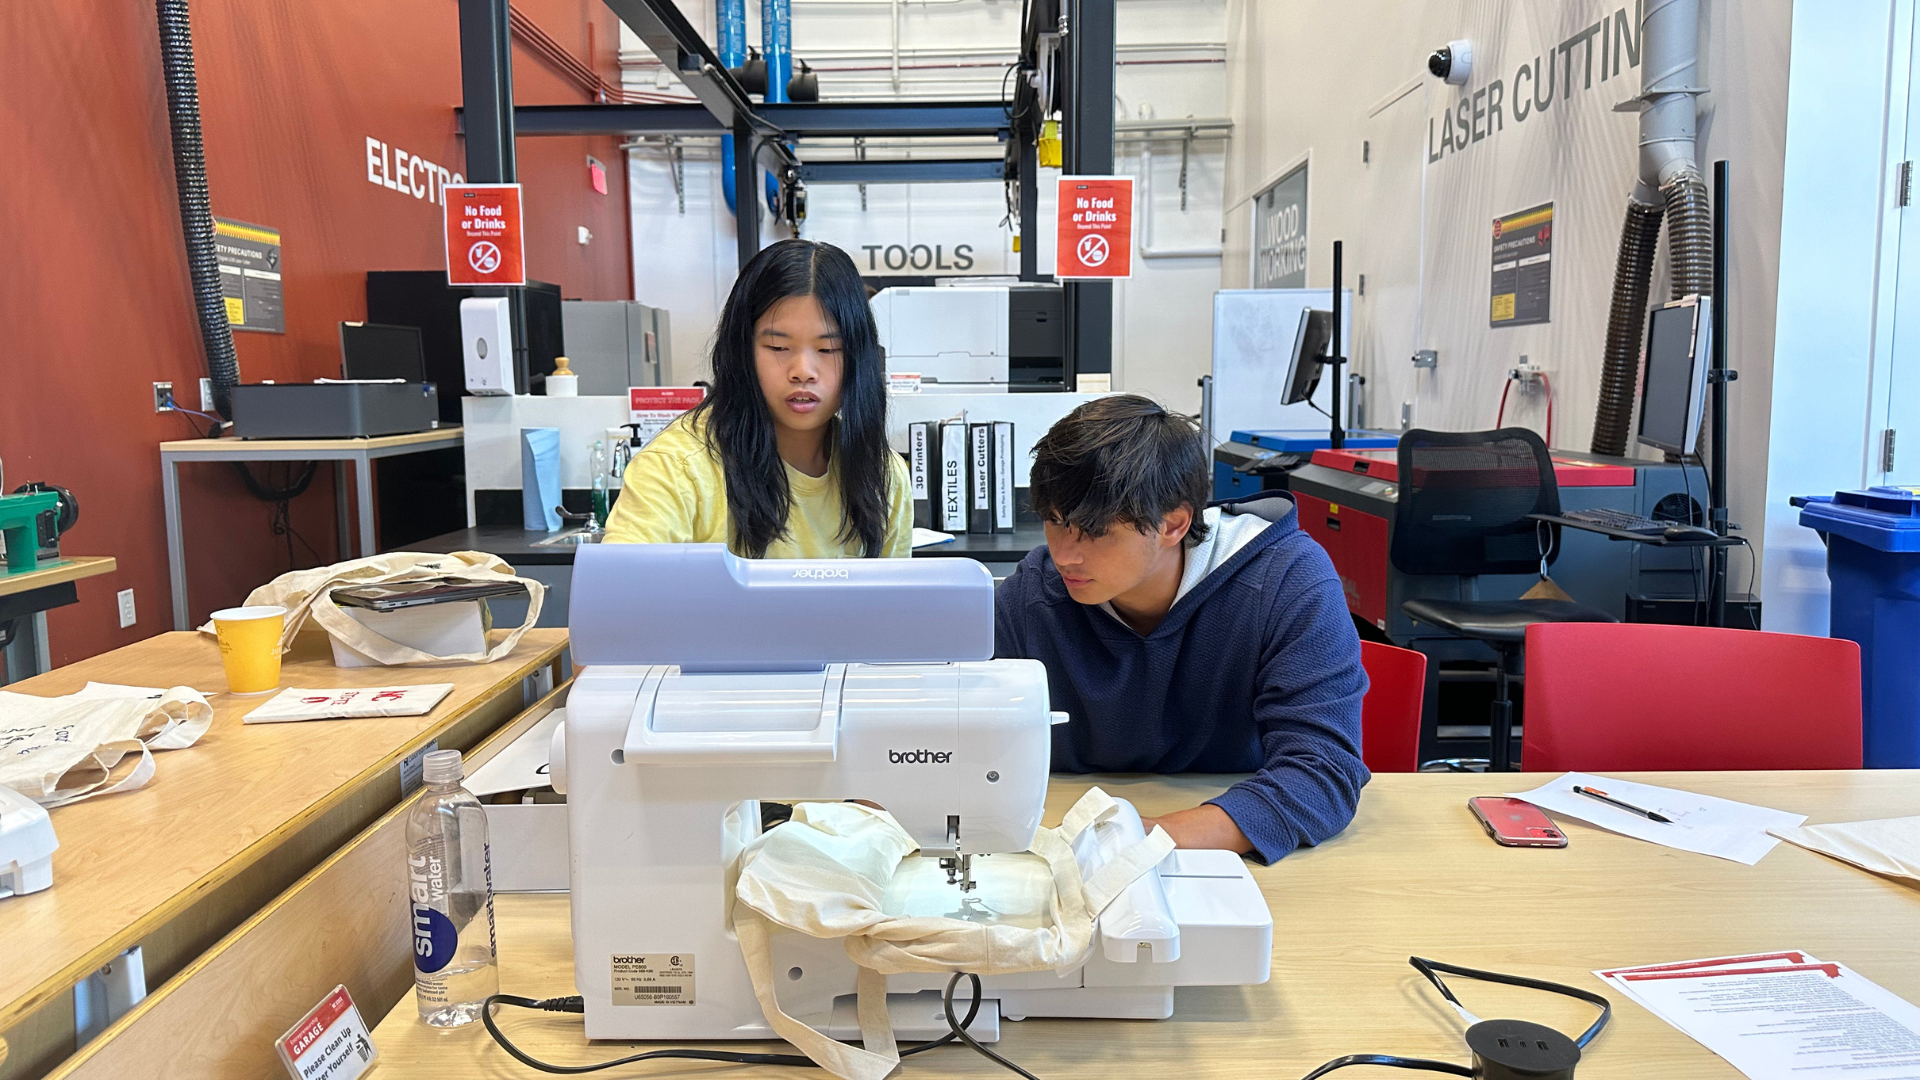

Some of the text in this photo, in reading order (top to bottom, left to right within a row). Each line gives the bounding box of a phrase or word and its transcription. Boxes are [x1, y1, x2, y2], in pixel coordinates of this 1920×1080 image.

[1428, 79, 1504, 164] LASER
[465, 205, 502, 216] No Food
[1072, 210, 1117, 222] or Drinks
[1076, 197, 1114, 208] No Food
[461, 218, 506, 230] or Drinks
[1266, 204, 1298, 246] WOOD
[228, 246, 262, 260] PRECAUTIONS
[862, 244, 974, 270] TOOLS
[1260, 235, 1306, 284] WORKING
[1493, 236, 1536, 253] SAFETY PRECAUTIONS
[977, 428, 986, 500] Laser Cutters
[916, 476, 924, 489] 3D
[947, 460, 958, 521] TEXTILES
[793, 569, 848, 579] brother
[888, 750, 952, 764] brother
[428, 856, 443, 901] water
[408, 854, 433, 958] smart
[484, 842, 496, 958] smartwater
[613, 956, 646, 964] brother
[290, 1016, 319, 1046] Entrepreneurship
[293, 1022, 324, 1055] GARAGE
[303, 1027, 352, 1078] Please Clean Up
[327, 1042, 354, 1073] Yourself
